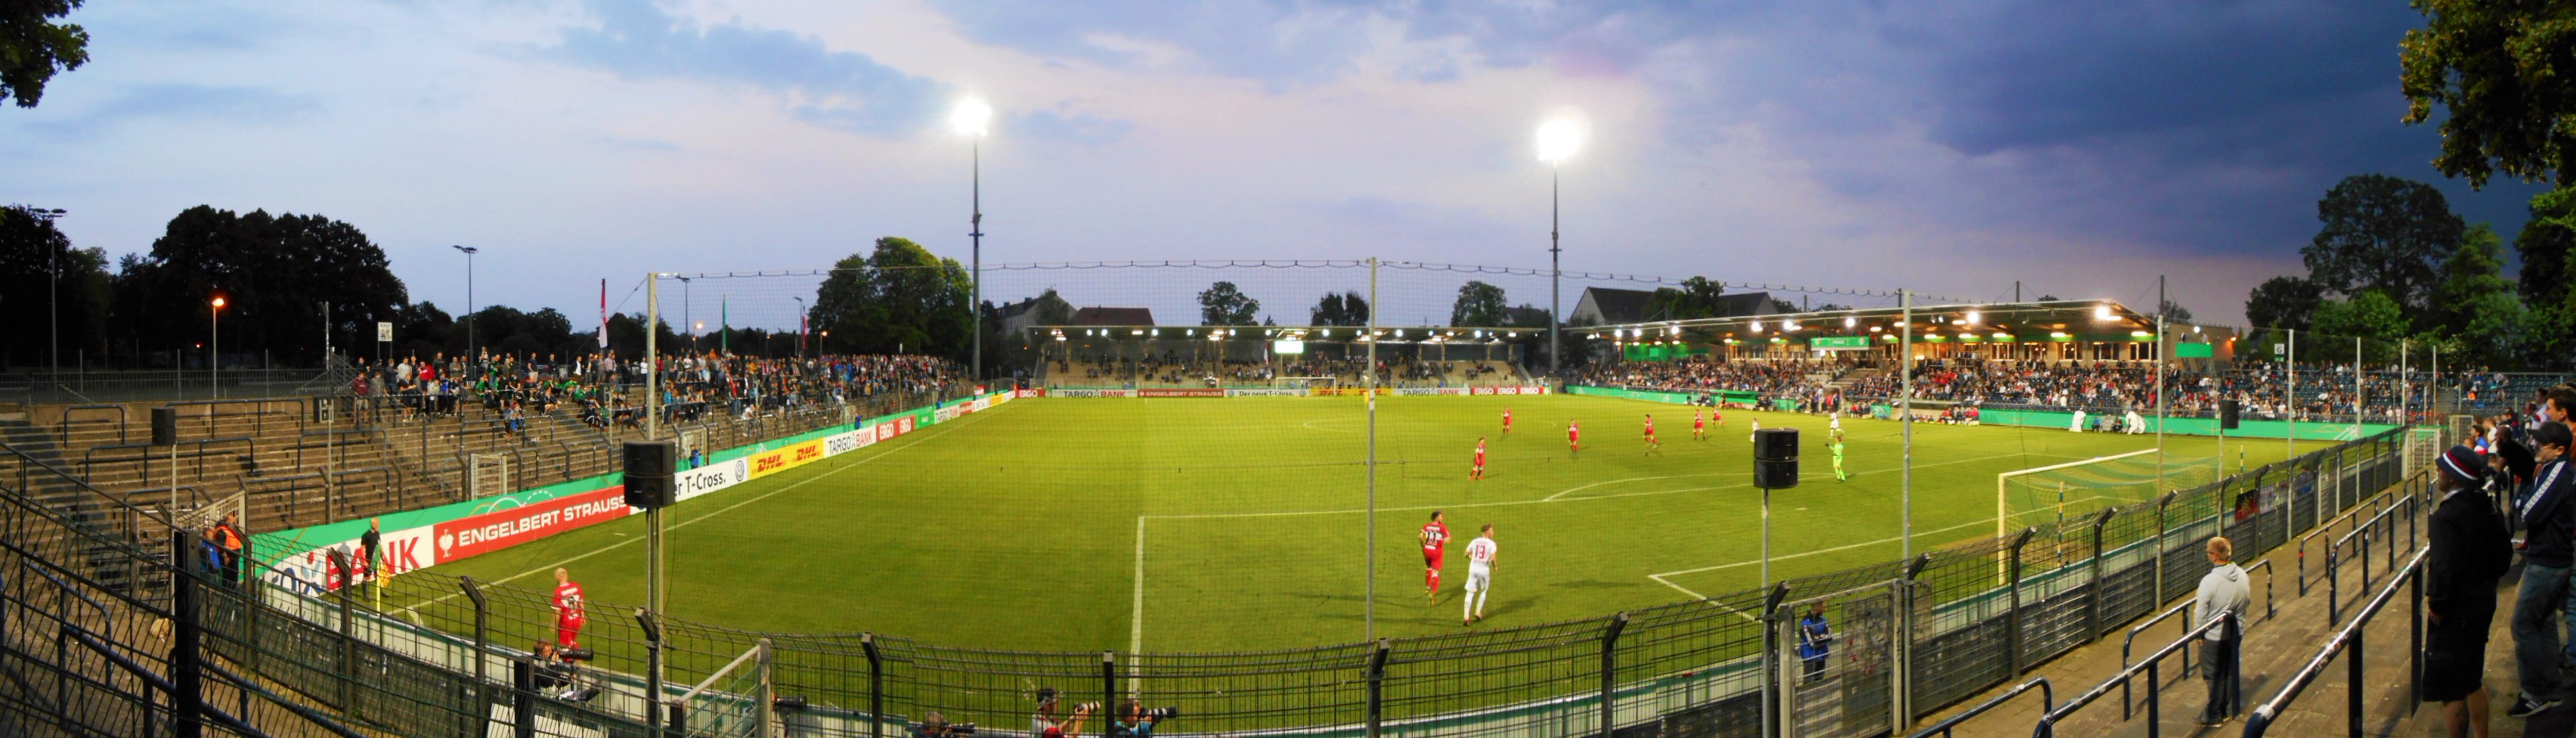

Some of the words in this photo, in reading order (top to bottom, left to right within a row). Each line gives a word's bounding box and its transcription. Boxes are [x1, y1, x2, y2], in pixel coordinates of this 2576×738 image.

[1019, 389, 1038, 398] ERGO
[879, 423, 893, 440] ERGO
[899, 418, 911, 434] ERGO
[797, 445, 818, 461] DHL
[757, 454, 783, 473] DHL
[685, 473, 726, 493] T-Cross.
[459, 510, 560, 547] ENGELBERT
[564, 495, 627, 522] STRAUSS
[1475, 544, 1486, 559] 13
